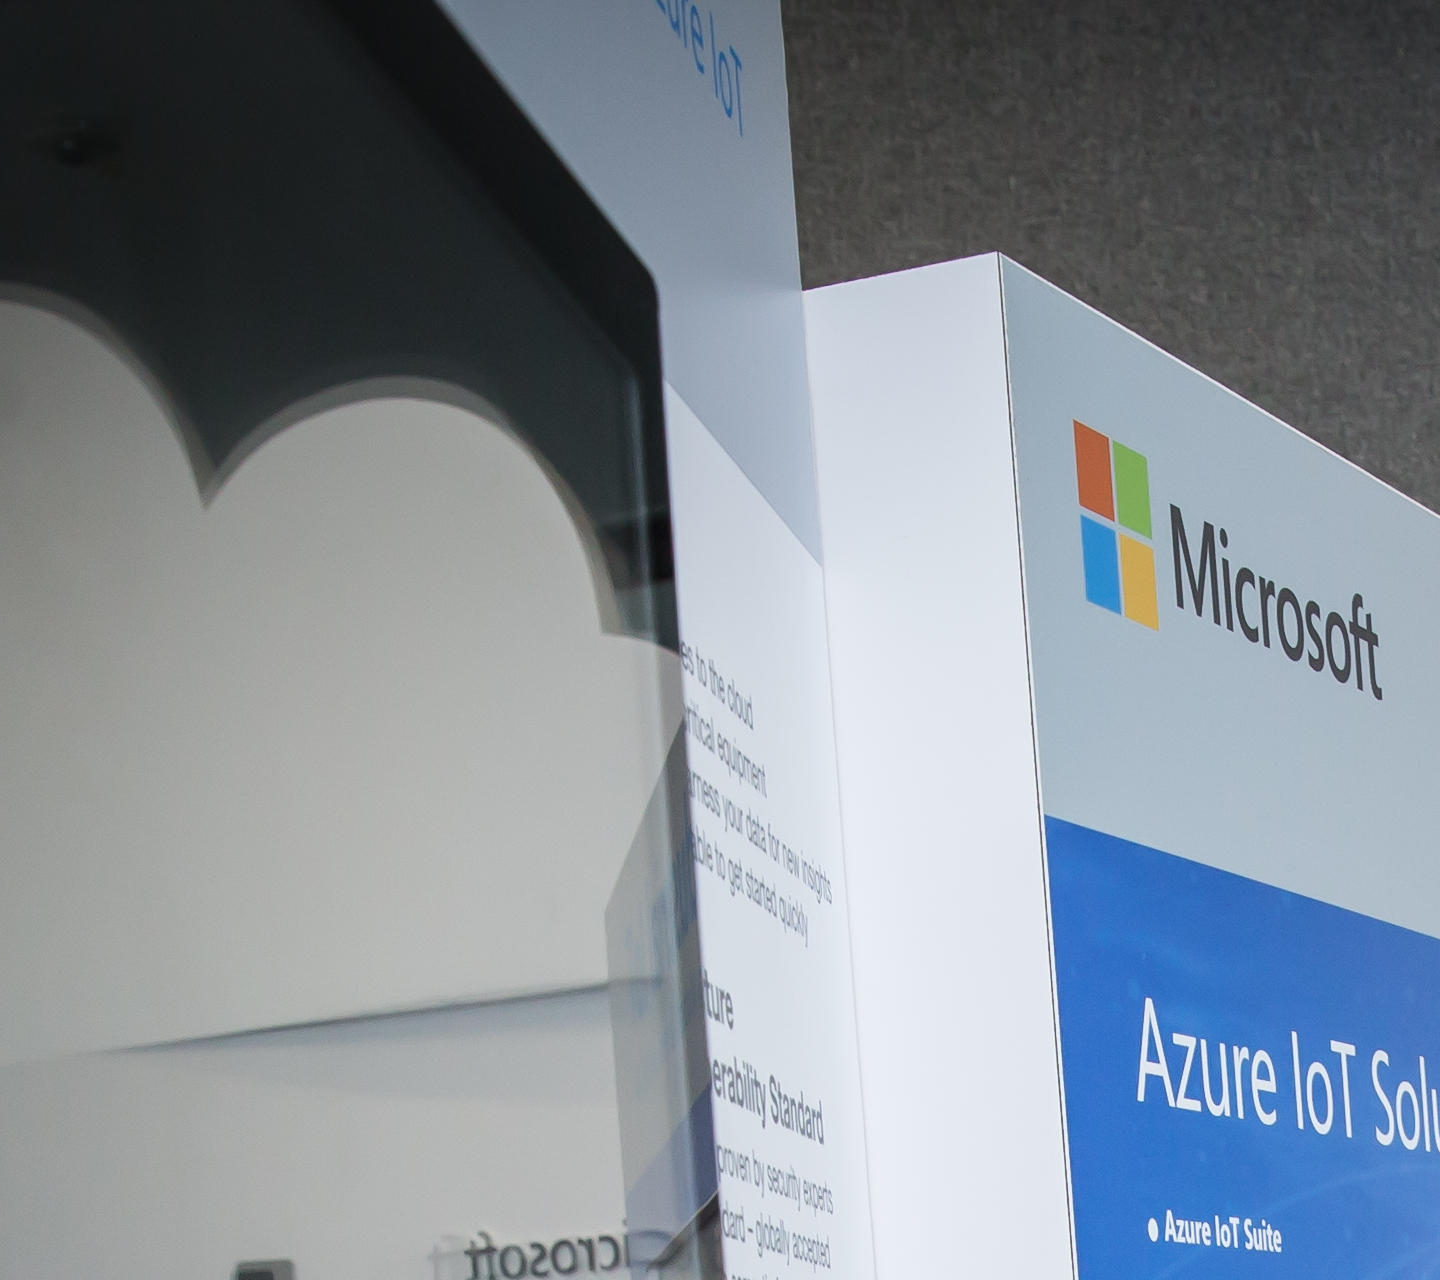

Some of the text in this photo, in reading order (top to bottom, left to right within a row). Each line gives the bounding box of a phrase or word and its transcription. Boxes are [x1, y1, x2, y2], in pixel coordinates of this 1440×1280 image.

[709, 12, 743, 137] IoT
[1169, 503, 1384, 701] Microsoft
[695, 646, 754, 730] to the cloud
[717, 732, 768, 798] equipment
[721, 793, 833, 905] your data for new insights
[714, 840, 726, 880] to
[728, 858, 744, 897] get
[745, 866, 777, 917] started
[779, 889, 808, 948] quickly
[769, 1074, 825, 1145] Standard
[1137, 996, 1277, 1127] Azure
[1290, 1031, 1356, 1139] IoT
[716, 1143, 833, 1217] proven by security experts
[756, 1211, 831, 1273] globally accepted
[1164, 1210, 1282, 1253] Azure IoT Suite
